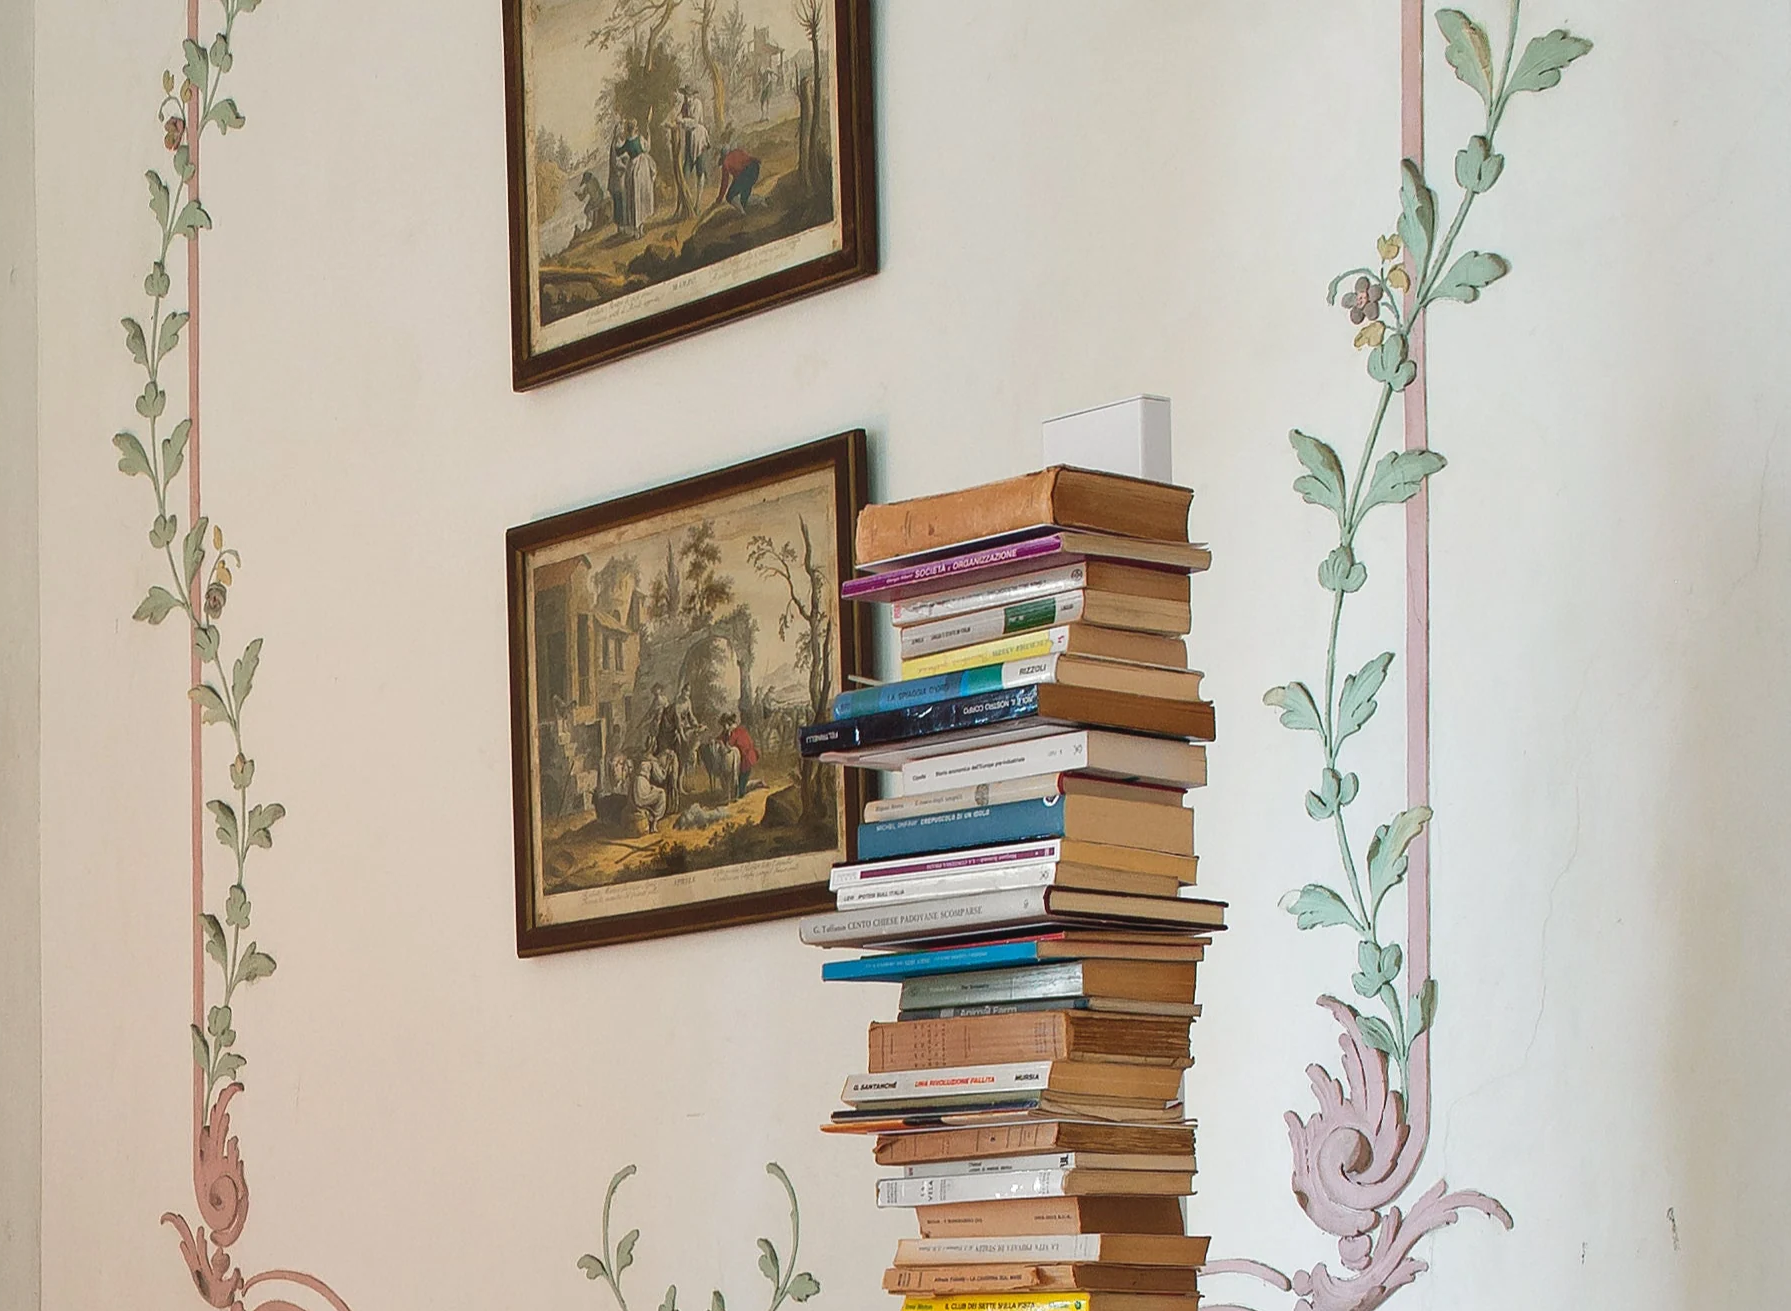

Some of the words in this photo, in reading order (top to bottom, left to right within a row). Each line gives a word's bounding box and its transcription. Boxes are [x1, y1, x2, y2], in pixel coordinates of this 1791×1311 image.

[914, 563, 946, 579] SOCIETÀ
[952, 548, 1017, 571] ORGANIZZAZIONE
[1019, 664, 1047, 676] RIZZOLI
[963, 702, 985, 715] CORPO
[985, 699, 1010, 711] NOSTRO
[806, 731, 839, 743] FELTRINELLI
[920, 813, 955, 826] CREPUSCOLO
[964, 812, 972, 820] UN
[813, 926, 820, 934] G.
[847, 918, 871, 930] CENTO
[872, 916, 898, 928] CHIESE
[900, 911, 938, 925] PADOVANE
[940, 906, 982, 921] SCOMPARSE
[928, 1078, 969, 1086] RIVOLUZIONE
[970, 1076, 995, 1084] FALLITA
[951, 1302, 966, 1310] CLUB
